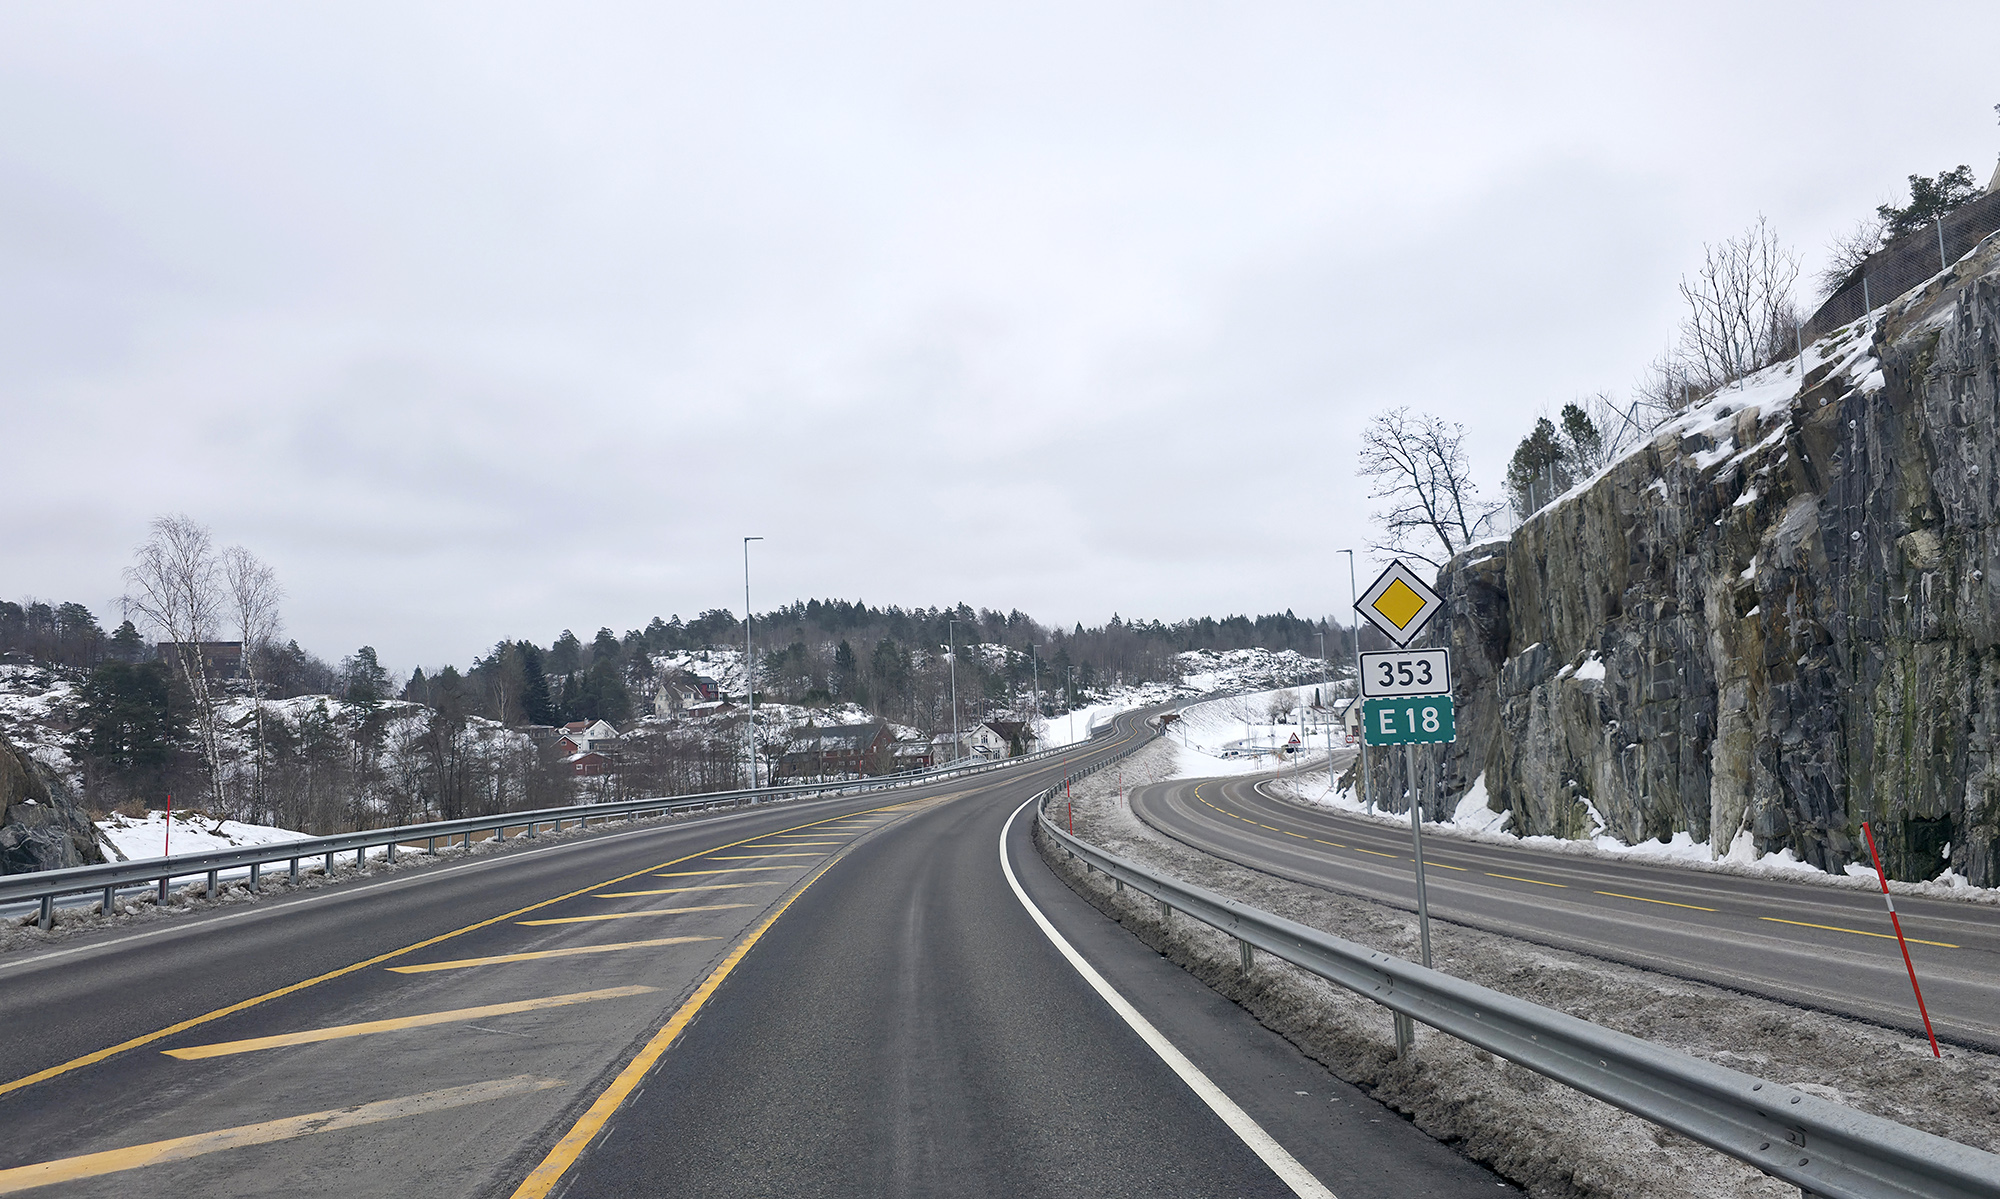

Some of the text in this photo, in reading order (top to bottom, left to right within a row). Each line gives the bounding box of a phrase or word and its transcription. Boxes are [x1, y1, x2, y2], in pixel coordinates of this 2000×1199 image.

[1377, 659, 1433, 687] 353
[1379, 706, 1440, 735] E 18
